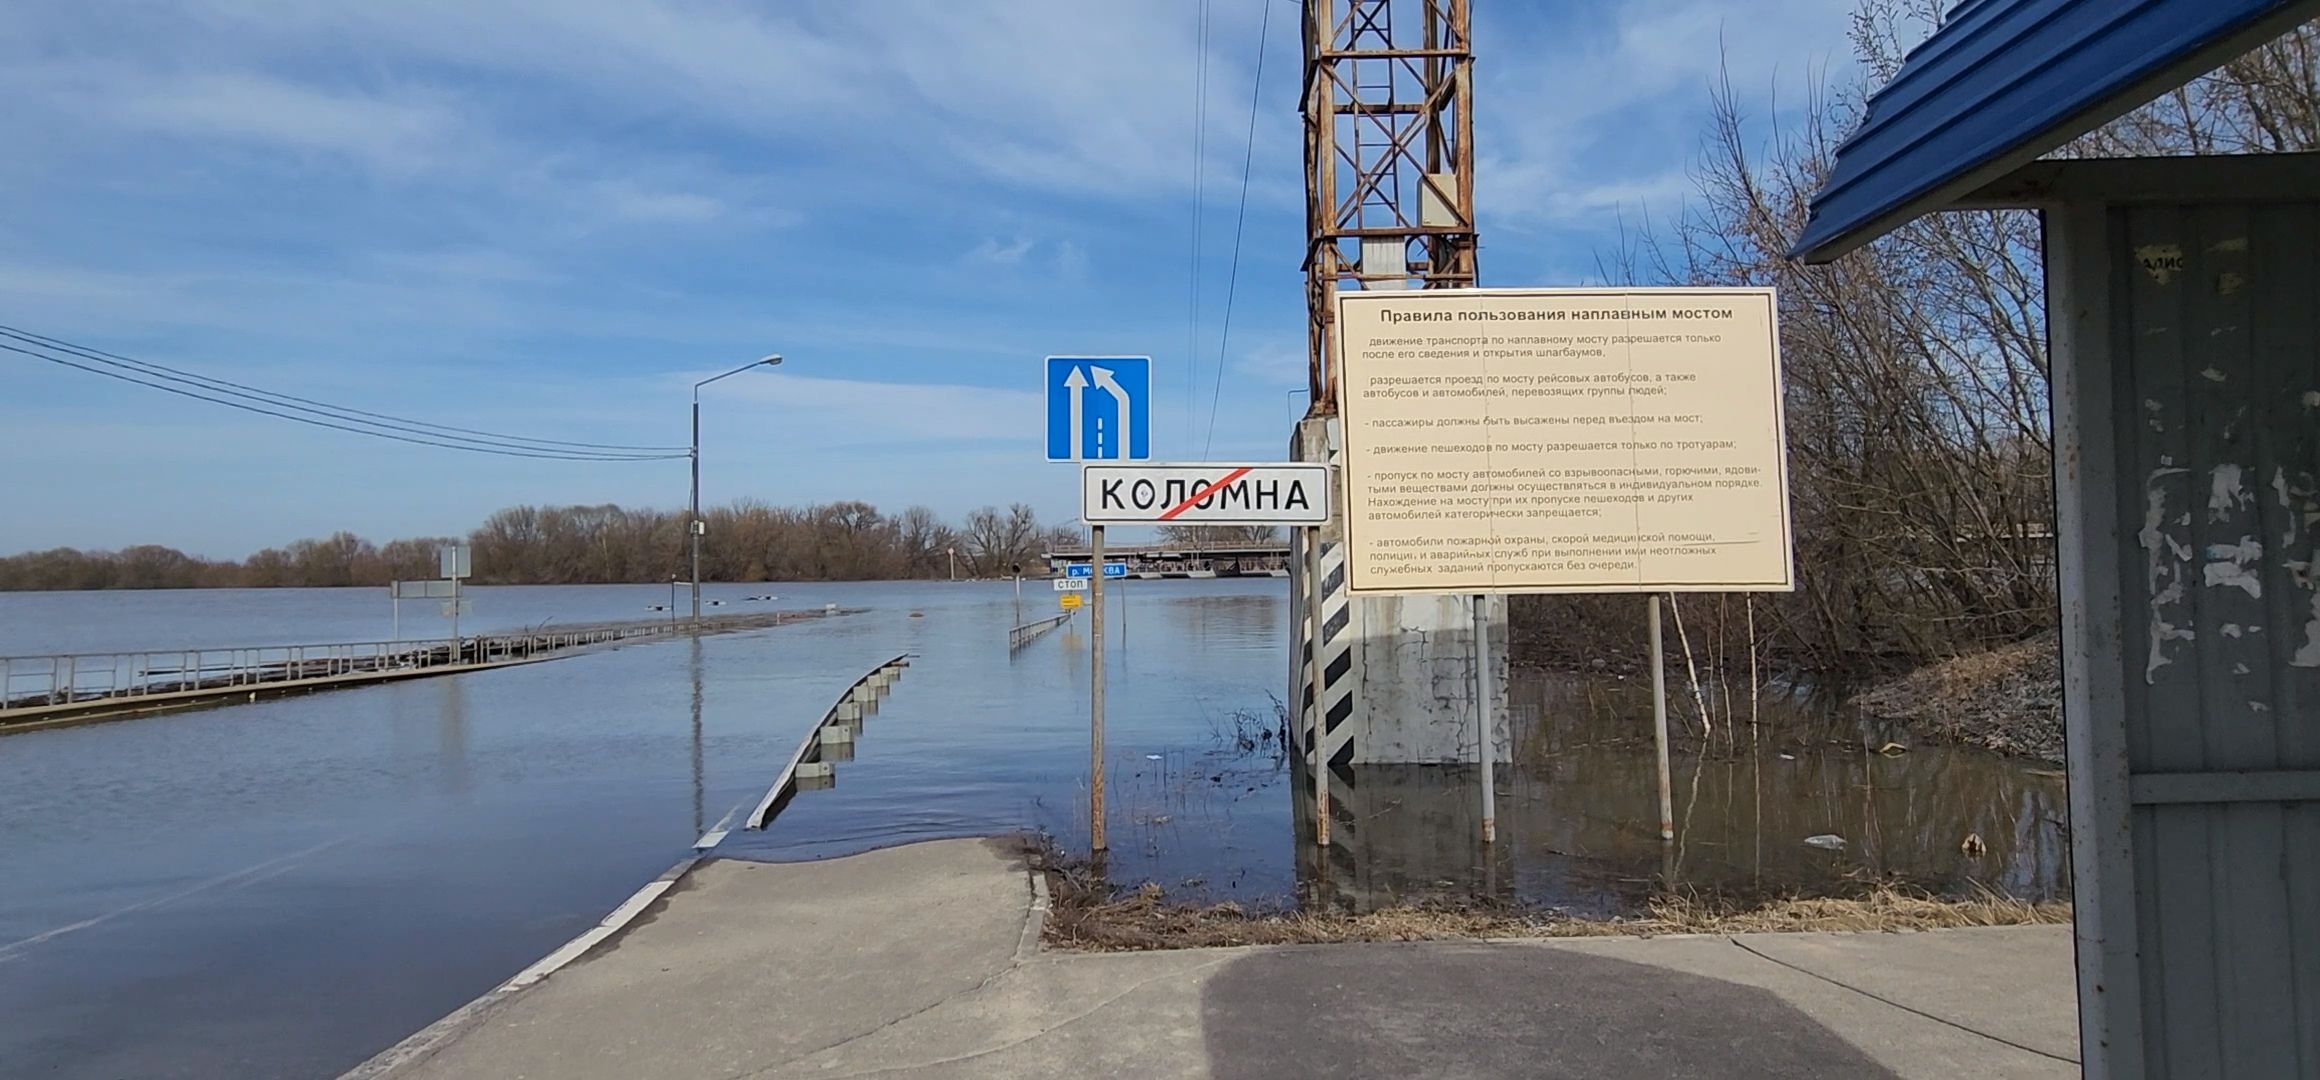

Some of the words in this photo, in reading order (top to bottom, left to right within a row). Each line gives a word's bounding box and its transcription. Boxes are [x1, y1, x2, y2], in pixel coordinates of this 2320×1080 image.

[1380, 308, 1452, 323] Правила
[1457, 310, 1565, 321] пользования
[1571, 309, 1666, 320] наплавным
[1672, 309, 1732, 319] мостом
[1368, 337, 1423, 346] движение
[1427, 337, 1488, 347] транспорта
[1507, 336, 1573, 346] наплавному
[1576, 336, 1609, 346] мосту
[1611, 335, 1682, 344] разрешается
[1685, 334, 1721, 342] только
[1362, 351, 1394, 359] после
[1397, 350, 1415, 358] его
[1418, 350, 1469, 359] сведения
[1482, 349, 1532, 359] открытия
[1369, 376, 1441, 386] разрешается
[1444, 376, 1485, 385] проезд
[1502, 375, 1534, 385] мосту
[1537, 375, 1590, 384] рейсовых
[1665, 373, 1696, 381] также
[1362, 387, 1419, 400] автобусов
[1511, 388, 1584, 398] перевозящих
[1587, 387, 1625, 397] группы
[1372, 419, 1433, 429] пассажиры
[1436, 418, 1479, 427] должны
[1482, 417, 1510, 425] быть
[1513, 416, 1569, 424] высажены
[1572, 416, 1605, 425] перед
[1608, 415, 1654, 424] въездом
[1657, 415, 1670, 423] на
[1372, 445, 1427, 455] движение
[1431, 444, 1492, 453] пешеходов
[1511, 443, 1543, 453] мосту
[1546, 442, 1617, 453] разрешается
[1660, 441, 1673, 449] по
[1374, 472, 1417, 482] пропуск
[1420, 471, 1433, 479] по
[1437, 471, 1470, 481] мосту
[1471, 467, 1545, 478] автомобилей
[1548, 469, 1561, 477] со
[1399, 484, 1467, 494] веществами
[1470, 484, 1514, 493] должны
[1517, 482, 1606, 493] осуществляться
[1619, 480, 1712, 491] индивидуальном
[1101, 478, 1310, 510] КОЛОМНА
[1367, 496, 1437, 507] Нахождение
[1456, 497, 1490, 507] мосту
[1492, 497, 1512, 506] при
[1515, 496, 1528, 504] их
[1531, 496, 1580, 506] пропуске
[1583, 494, 1644, 504] пешеходов
[1656, 494, 1693, 504] других
[1368, 509, 1441, 520] автомобилей
[1444, 509, 1523, 520] категорически
[1376, 536, 1443, 547] автомобили
[1446, 535, 1501, 547] пожарной
[1551, 535, 1589, 545] скорой
[1494, 547, 1528, 560] служб
[1531, 549, 1551, 559] при
[1554, 548, 1621, 556] выполнении
[1649, 546, 1716, 555] неотложных
[1082, 566, 1121, 575] МКВА
[1370, 563, 1432, 576] служебных
[1437, 562, 1484, 573] заданий
[1486, 562, 1563, 574] пропускаются
[1566, 560, 1585, 570] без
[1057, 580, 1084, 589] СТОП
